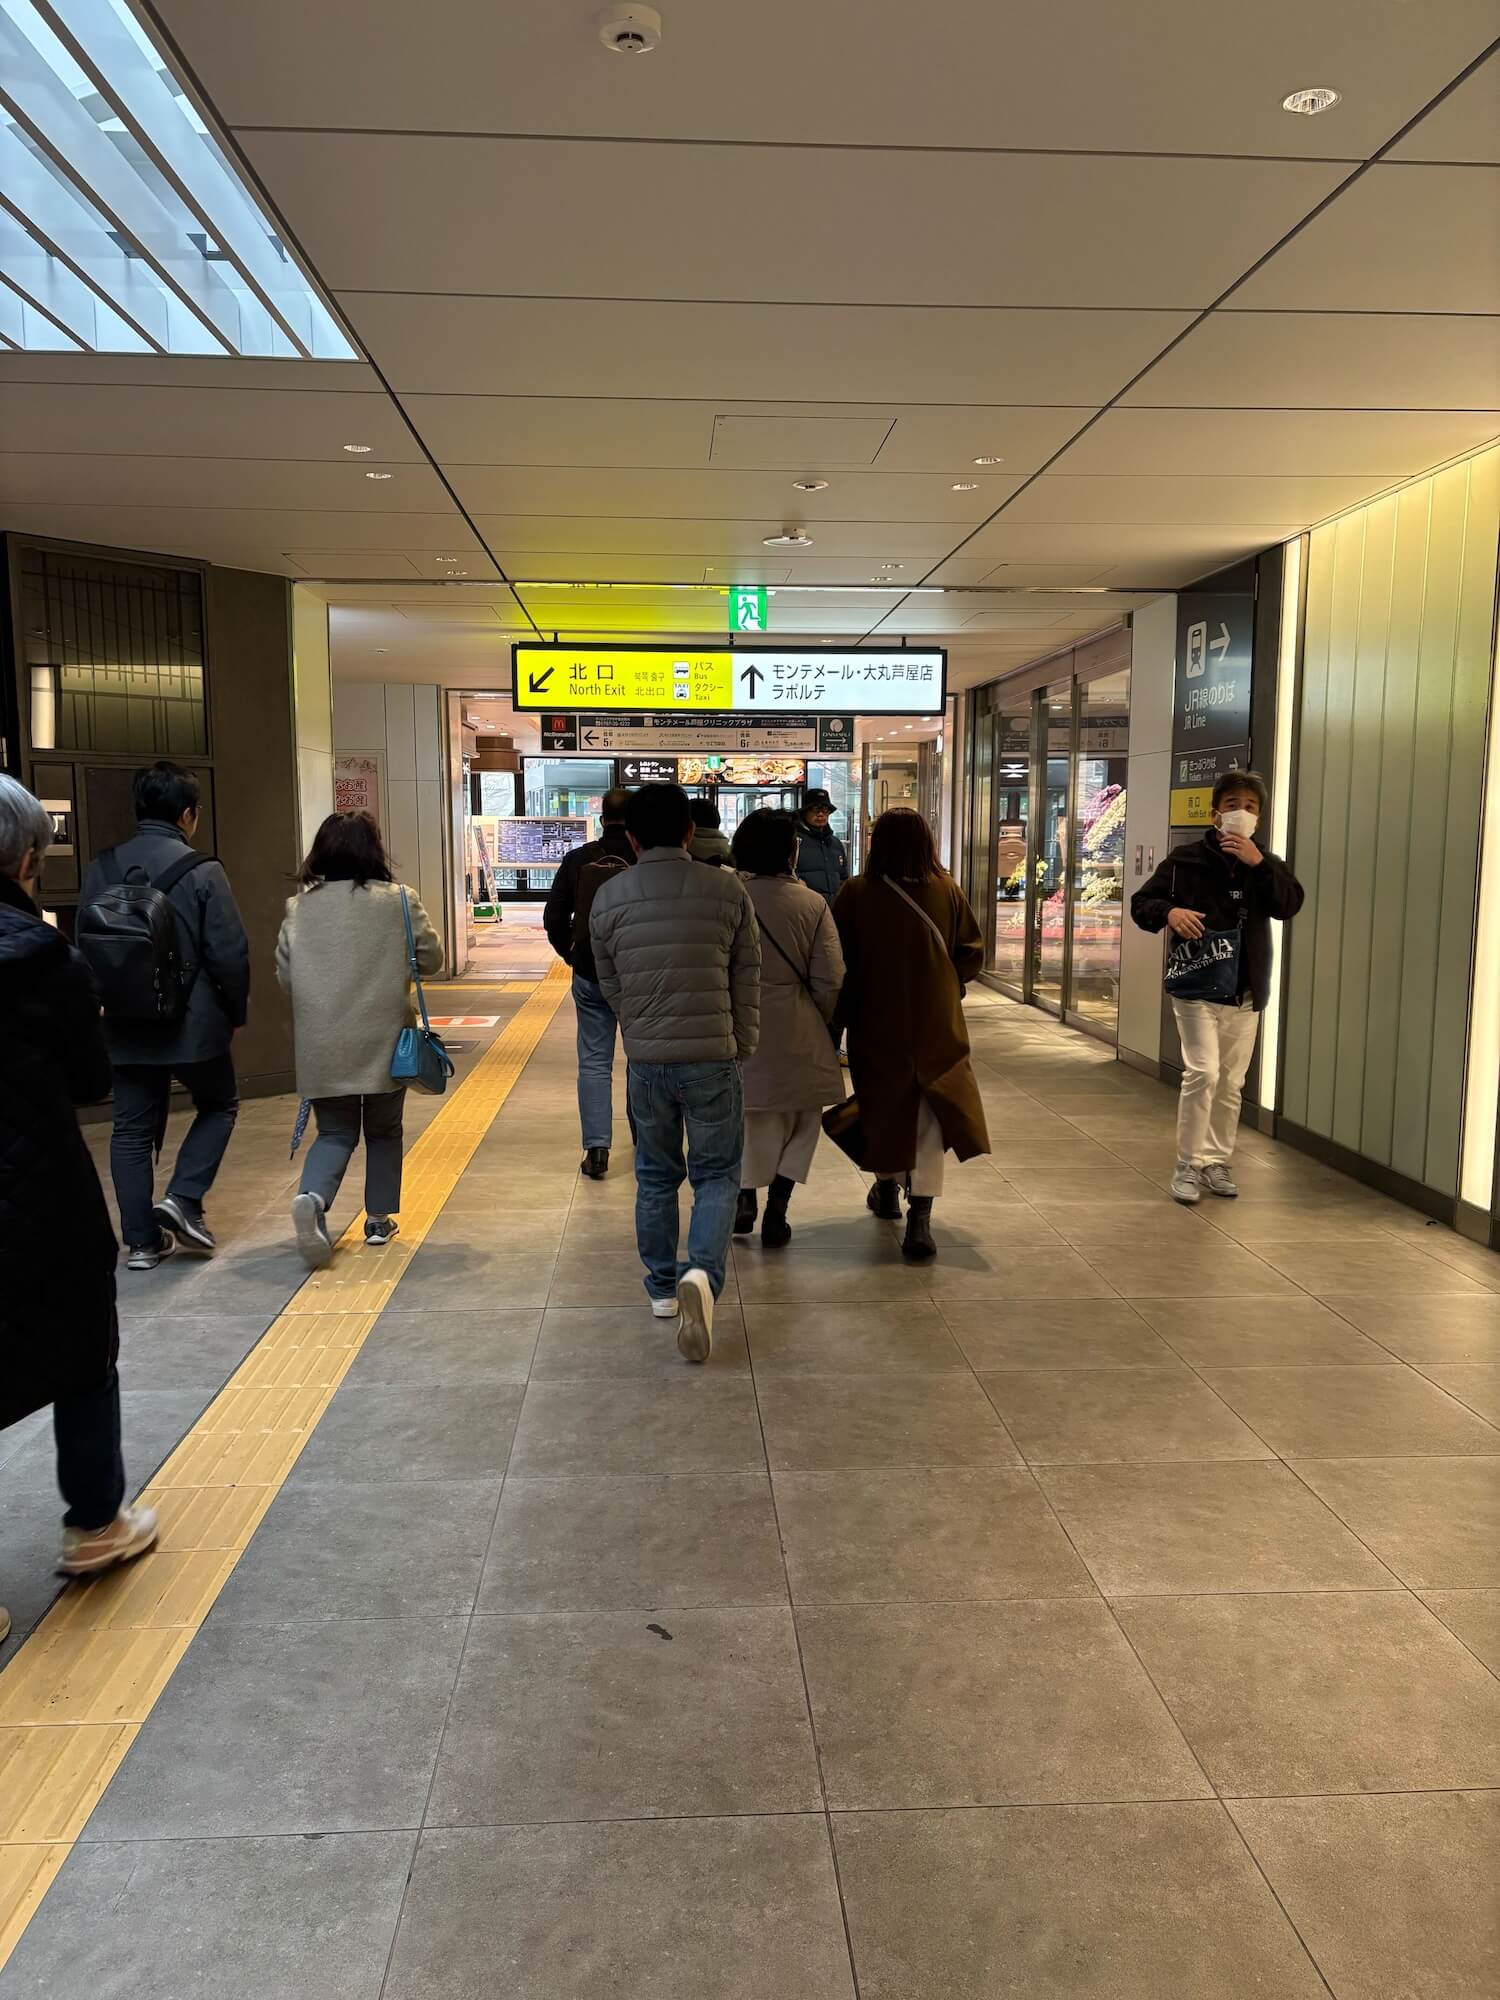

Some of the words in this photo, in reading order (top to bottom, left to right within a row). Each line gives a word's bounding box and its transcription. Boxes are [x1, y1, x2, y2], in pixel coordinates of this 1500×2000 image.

[569, 663, 614, 681] 北口
[694, 662, 714, 671] バス
[772, 664, 934, 681] モンテメール・大丸芦屋店
[569, 683, 602, 696] North
[604, 683, 626, 696] Exit
[635, 687, 665, 696] 北出口
[695, 683, 724, 692] タクシー
[772, 684, 826, 700] ラポルテ
[1184, 680, 1236, 712] JR線のりば
[1183, 715, 1192, 730] JR
[1192, 713, 1207, 729] Line
